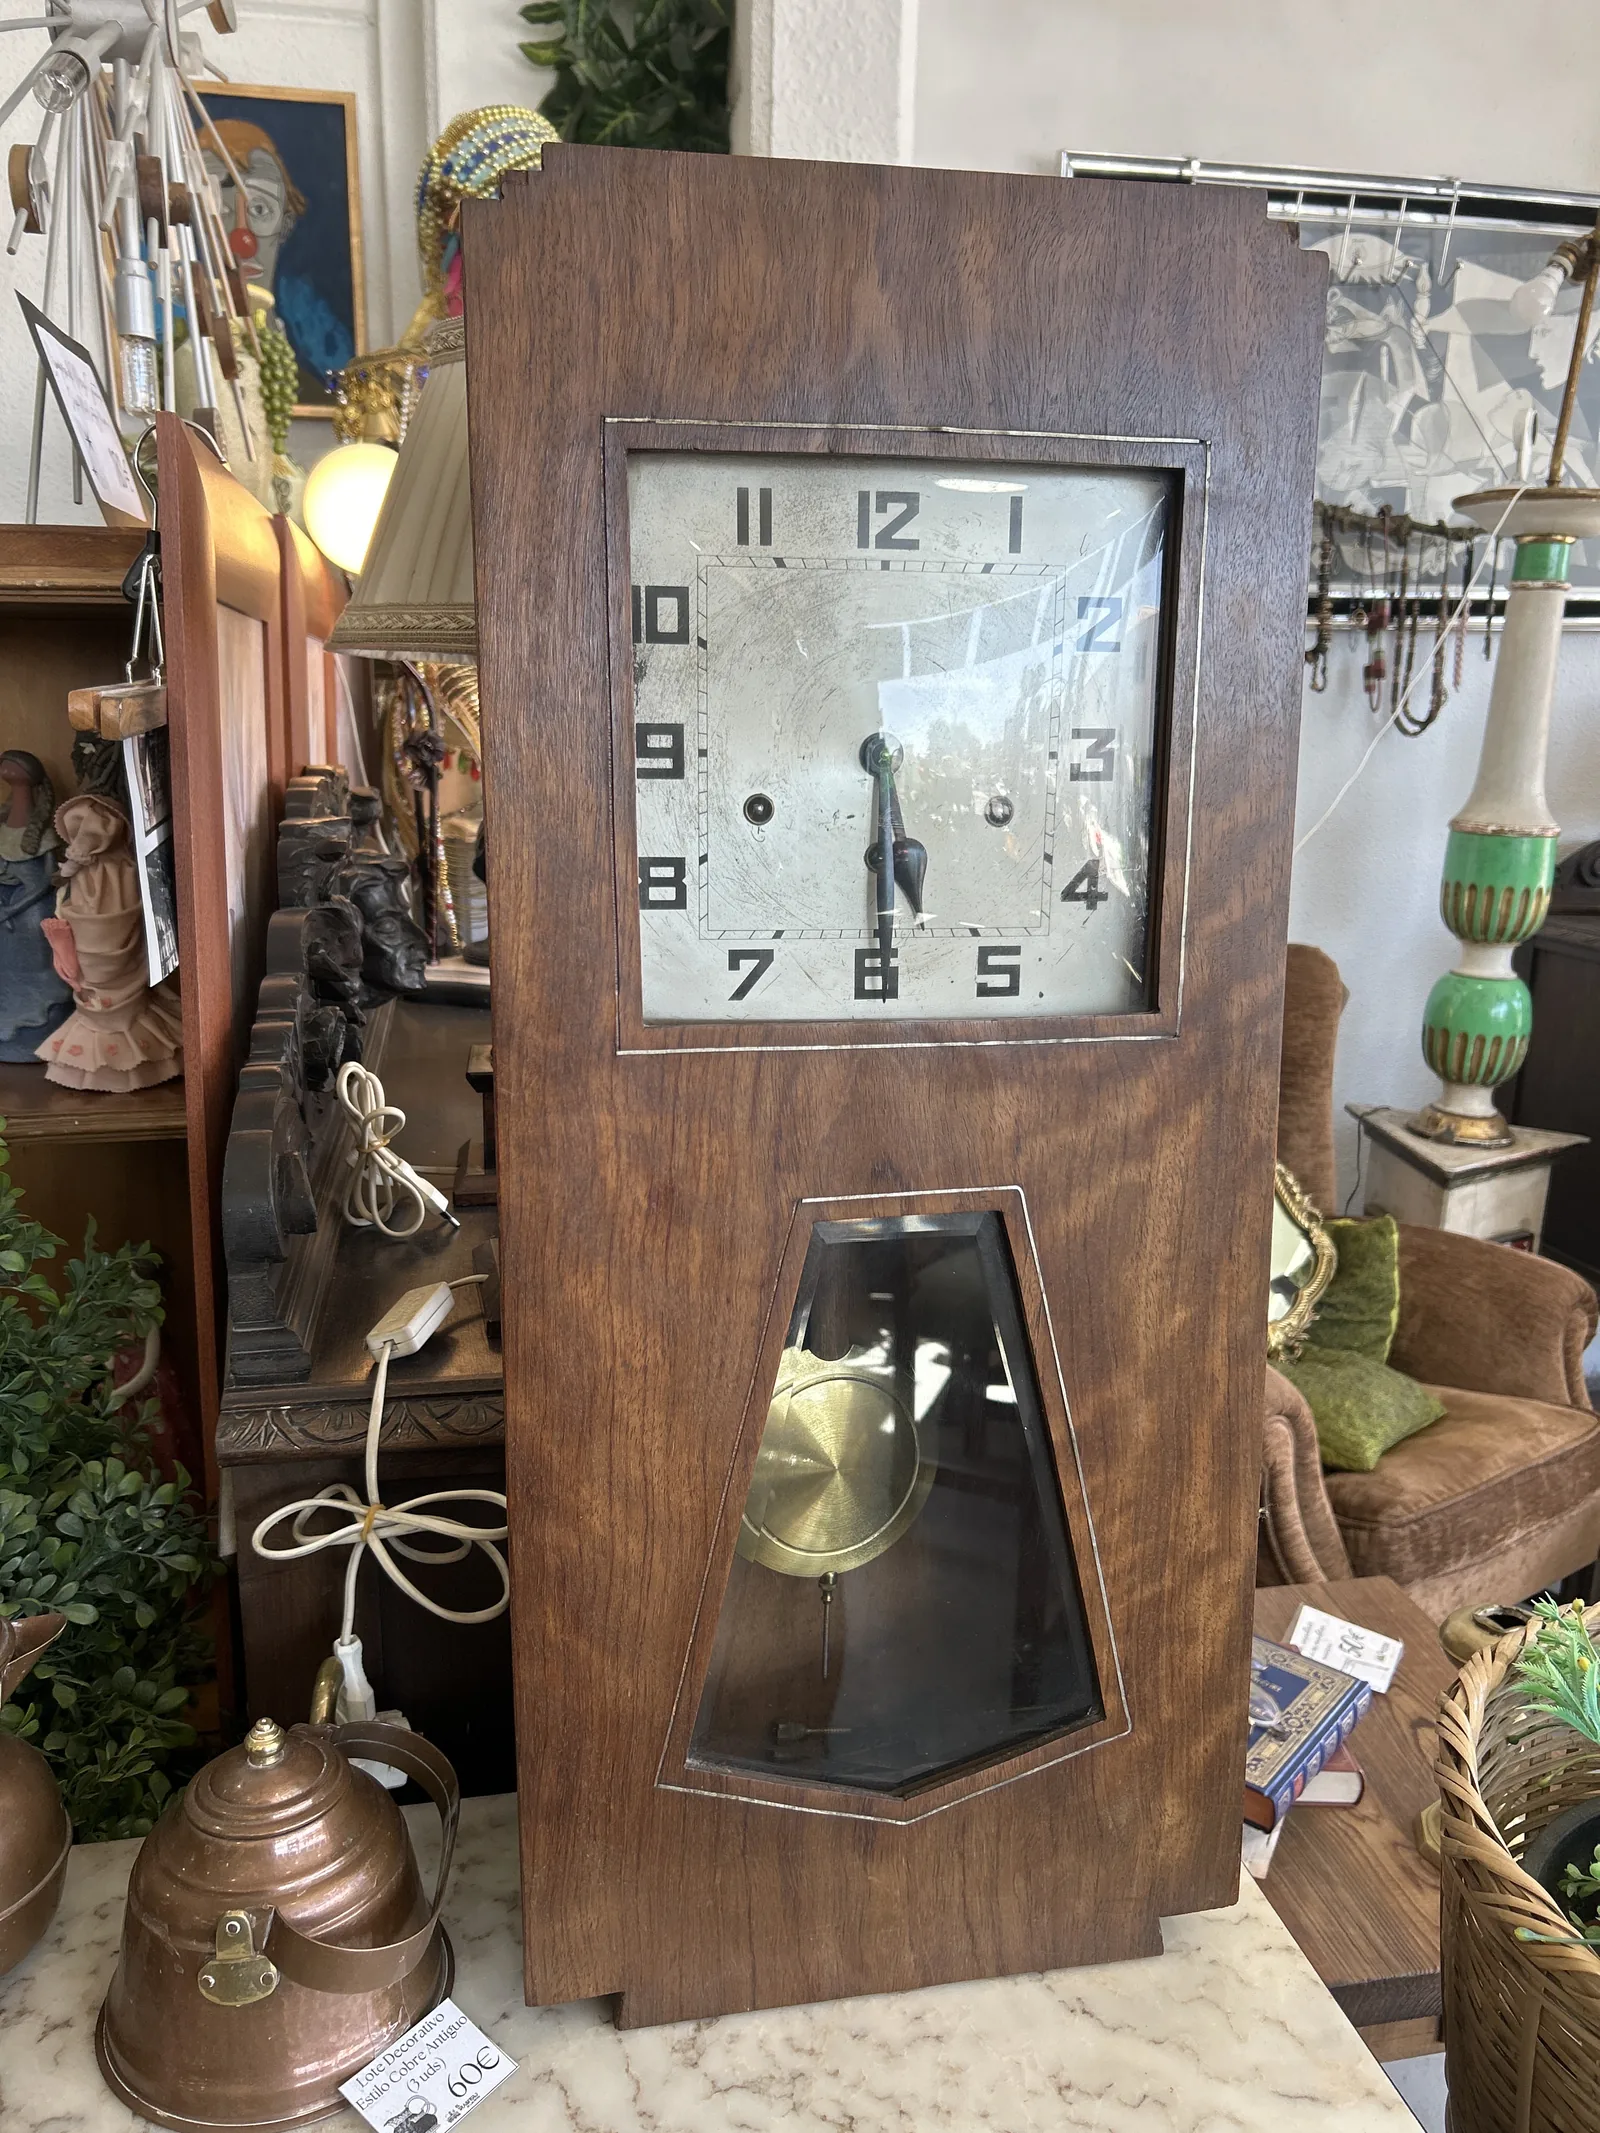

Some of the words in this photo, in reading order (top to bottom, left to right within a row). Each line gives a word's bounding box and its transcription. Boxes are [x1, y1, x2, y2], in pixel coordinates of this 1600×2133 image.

[736, 487, 772, 546] 11
[857, 490, 920, 550] 12
[1009, 496, 1023, 553] 1
[1076, 597, 1122, 652] 2
[636, 723, 684, 779] 9
[1069, 728, 1116, 781] 3
[637, 857, 687, 910] 8
[1060, 859, 1109, 910] 4
[728, 949, 774, 1000] 7
[854, 948, 898, 1000] 6
[976, 945, 1021, 997] 5
[356, 2062, 386, 2088] Lote
[383, 2013, 445, 2066] Decorativo
[356, 2082, 390, 2111] Estilo
[389, 2051, 427, 2084] Cobre
[425, 2015, 468, 2055] Antiguo
[407, 2077, 420, 2094] (3
[419, 2057, 447, 2082] uds)
[447, 2045, 500, 2098] 60€
